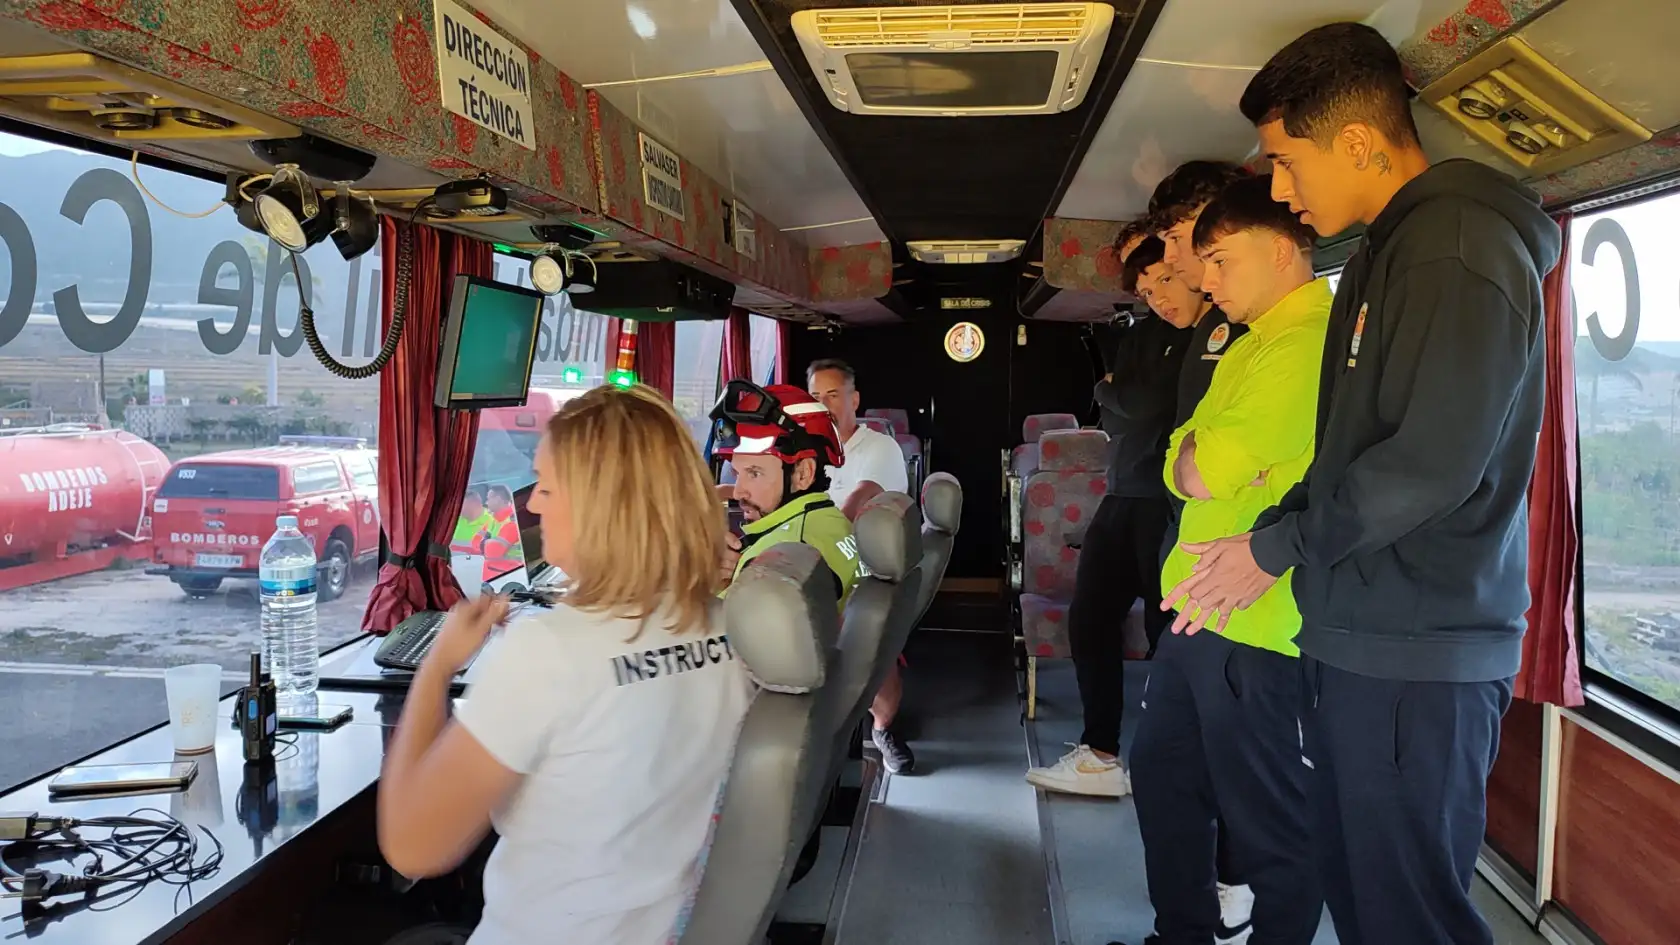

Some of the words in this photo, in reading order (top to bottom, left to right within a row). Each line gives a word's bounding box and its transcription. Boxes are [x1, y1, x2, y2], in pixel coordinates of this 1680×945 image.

[443, 13, 527, 96] DIRECCIÓN
[458, 75, 524, 142] TÉCNICA
[19, 466, 108, 492] BOMBEROS
[48, 488, 92, 512] ADEJE
[170, 533, 260, 545] BOMBEROS
